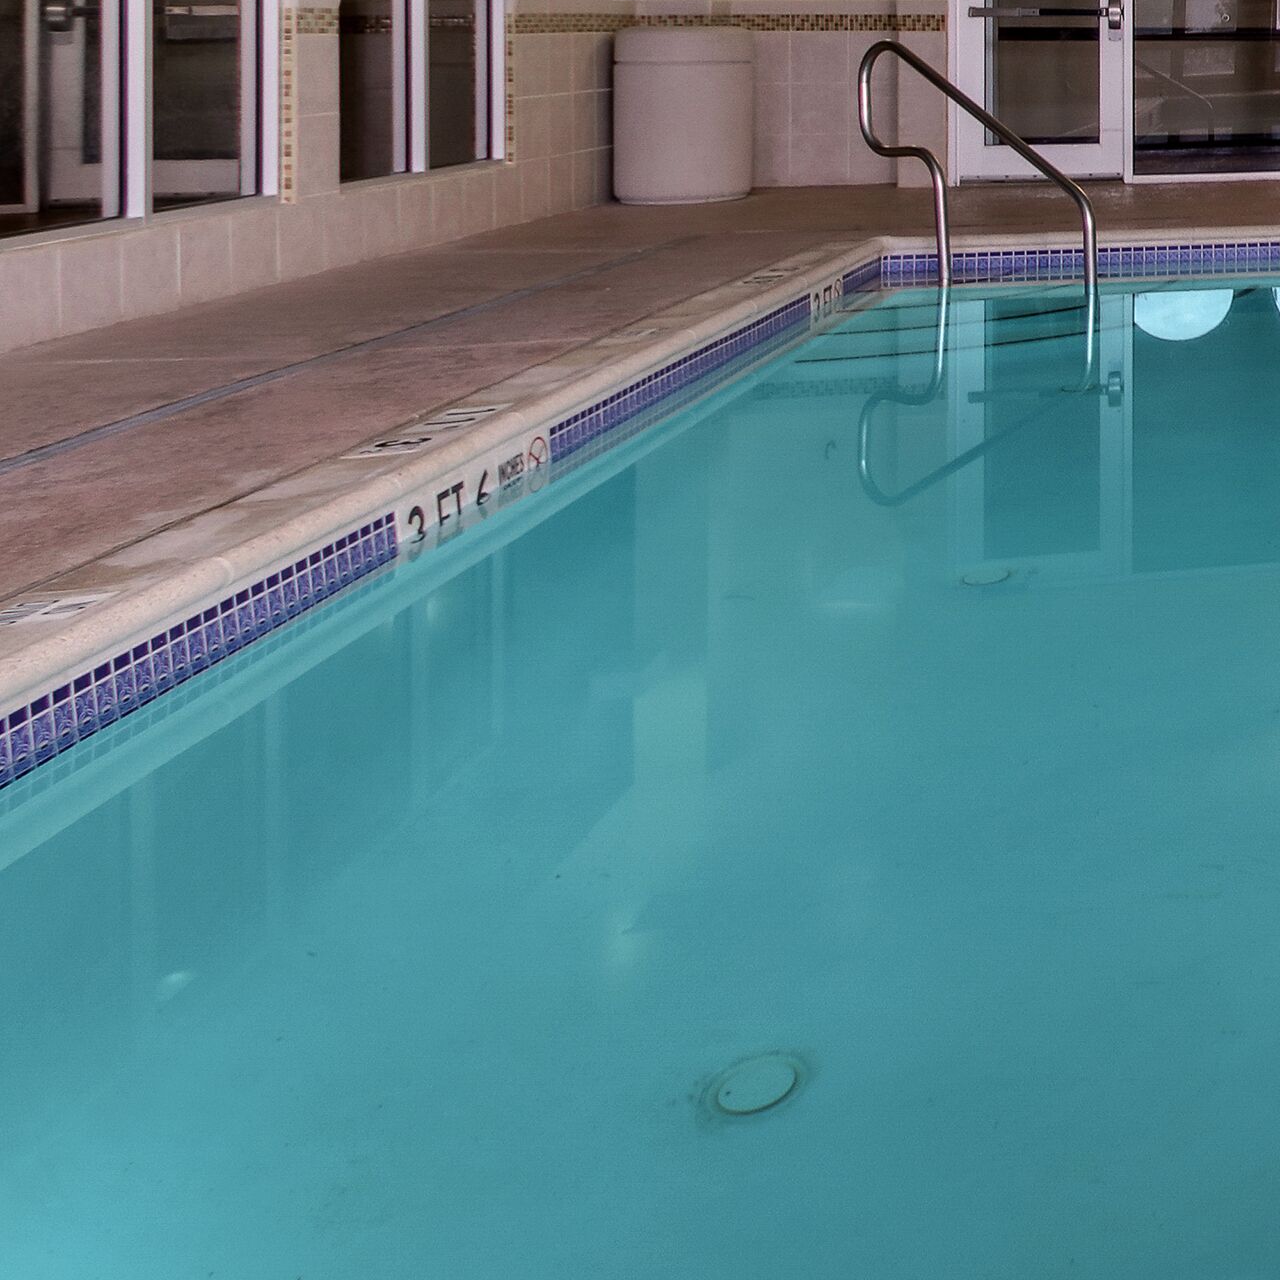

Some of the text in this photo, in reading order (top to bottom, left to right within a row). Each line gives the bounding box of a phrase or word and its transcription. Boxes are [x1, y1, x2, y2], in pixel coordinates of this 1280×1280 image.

[408, 505, 426, 543] 3
[437, 481, 464, 526] FT
[476, 469, 490, 506] 6
